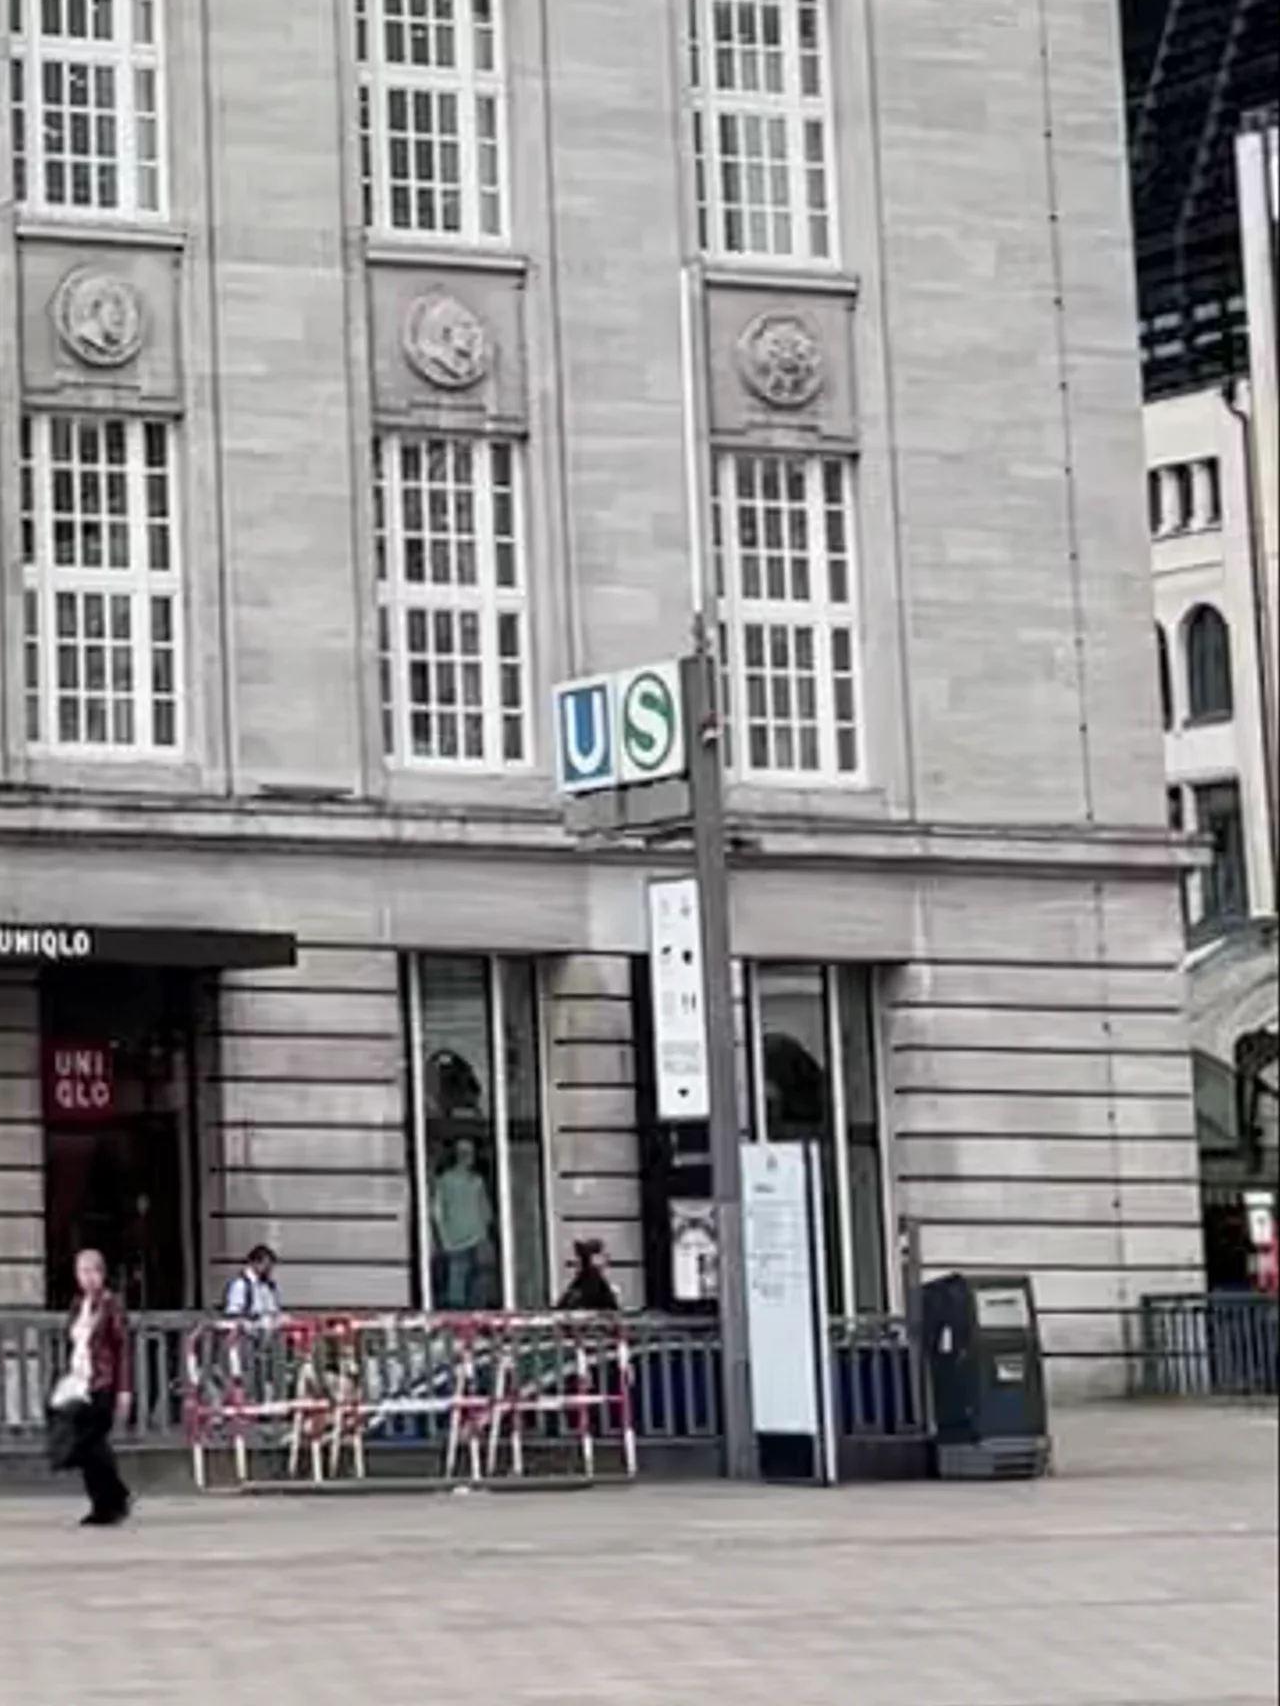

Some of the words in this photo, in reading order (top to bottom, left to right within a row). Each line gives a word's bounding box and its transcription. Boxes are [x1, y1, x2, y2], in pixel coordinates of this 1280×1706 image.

[566, 689, 605, 774] U
[628, 679, 669, 765] S
[55, 1049, 103, 1077] UNI
[55, 1079, 110, 1108] QLO
